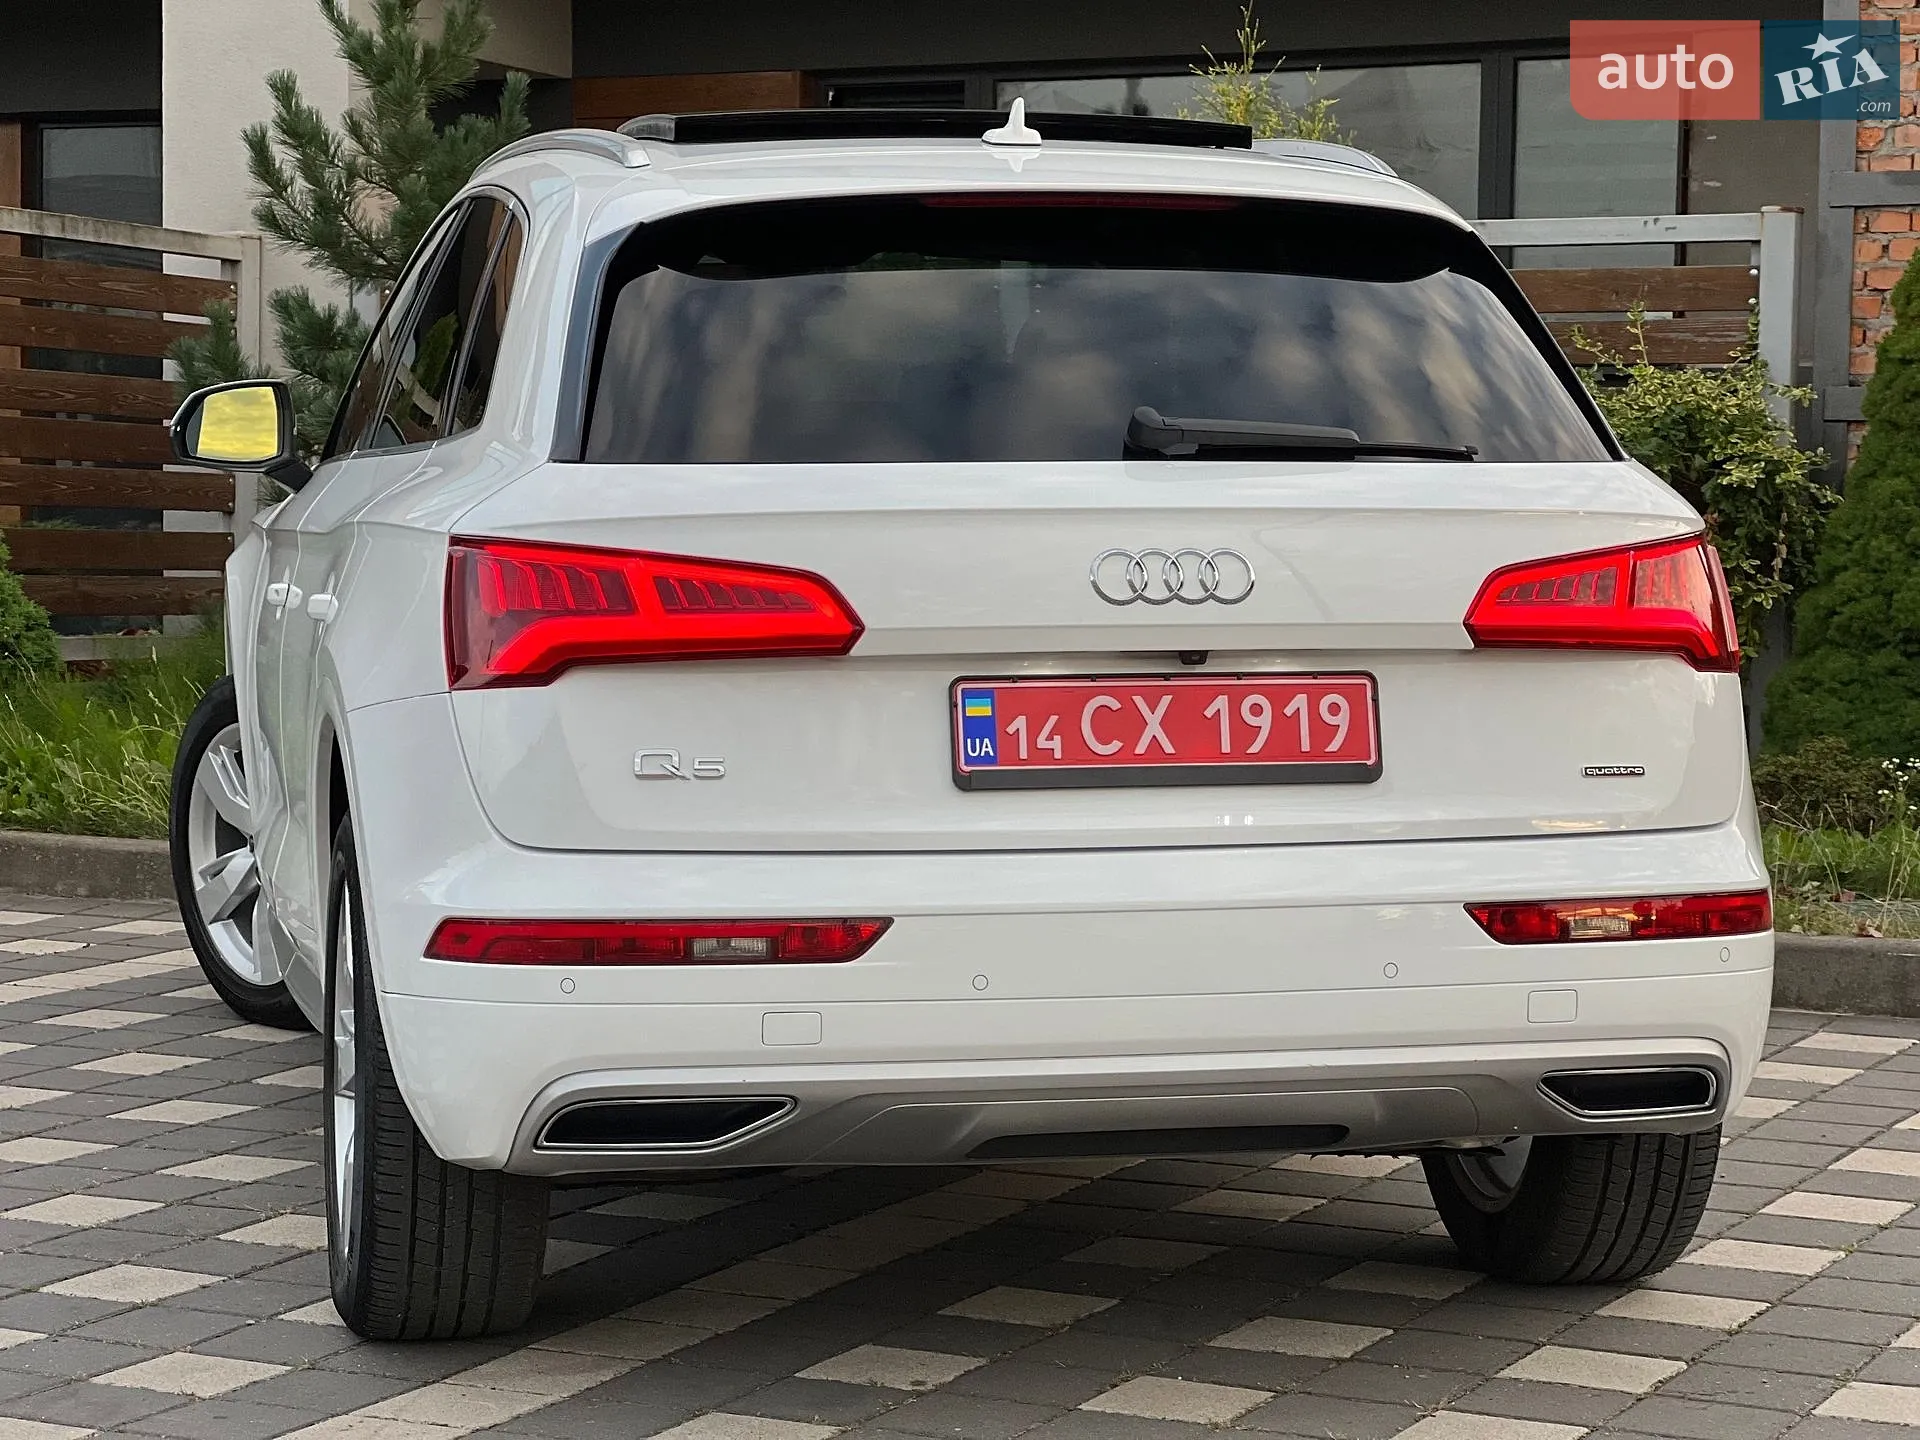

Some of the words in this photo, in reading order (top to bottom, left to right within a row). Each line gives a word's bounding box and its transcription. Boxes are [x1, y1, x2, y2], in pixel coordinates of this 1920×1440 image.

[1005, 715, 1062, 760] 14
[1081, 694, 1176, 756] CX
[1203, 693, 1350, 754] 1919
[966, 737, 994, 758] UA
[1586, 767, 1644, 776] quattro
